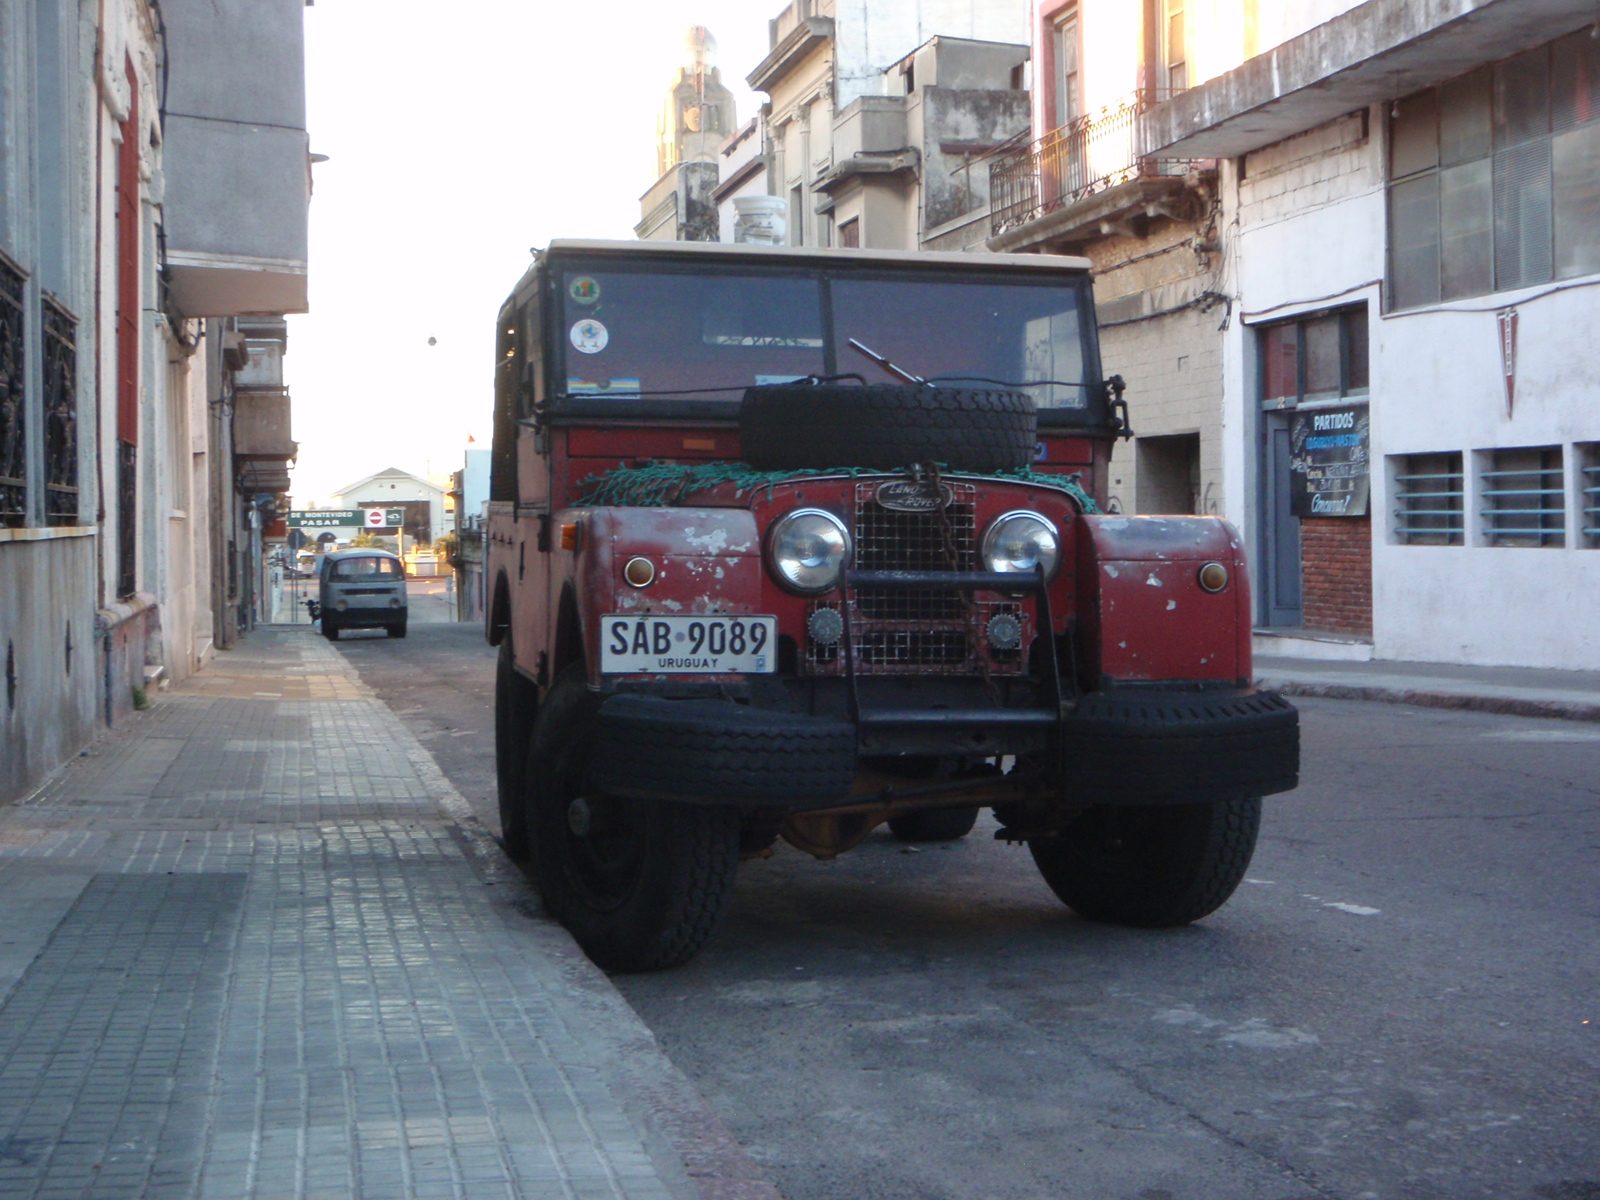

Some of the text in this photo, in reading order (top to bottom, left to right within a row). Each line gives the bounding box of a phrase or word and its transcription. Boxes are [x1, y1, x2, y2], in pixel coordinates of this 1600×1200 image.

[1314, 412, 1354, 431] PARTIDOS
[888, 484, 919, 494] LAND
[610, 621, 767, 655] SAB 9089
[658, 658, 718, 668] URUGUAY
